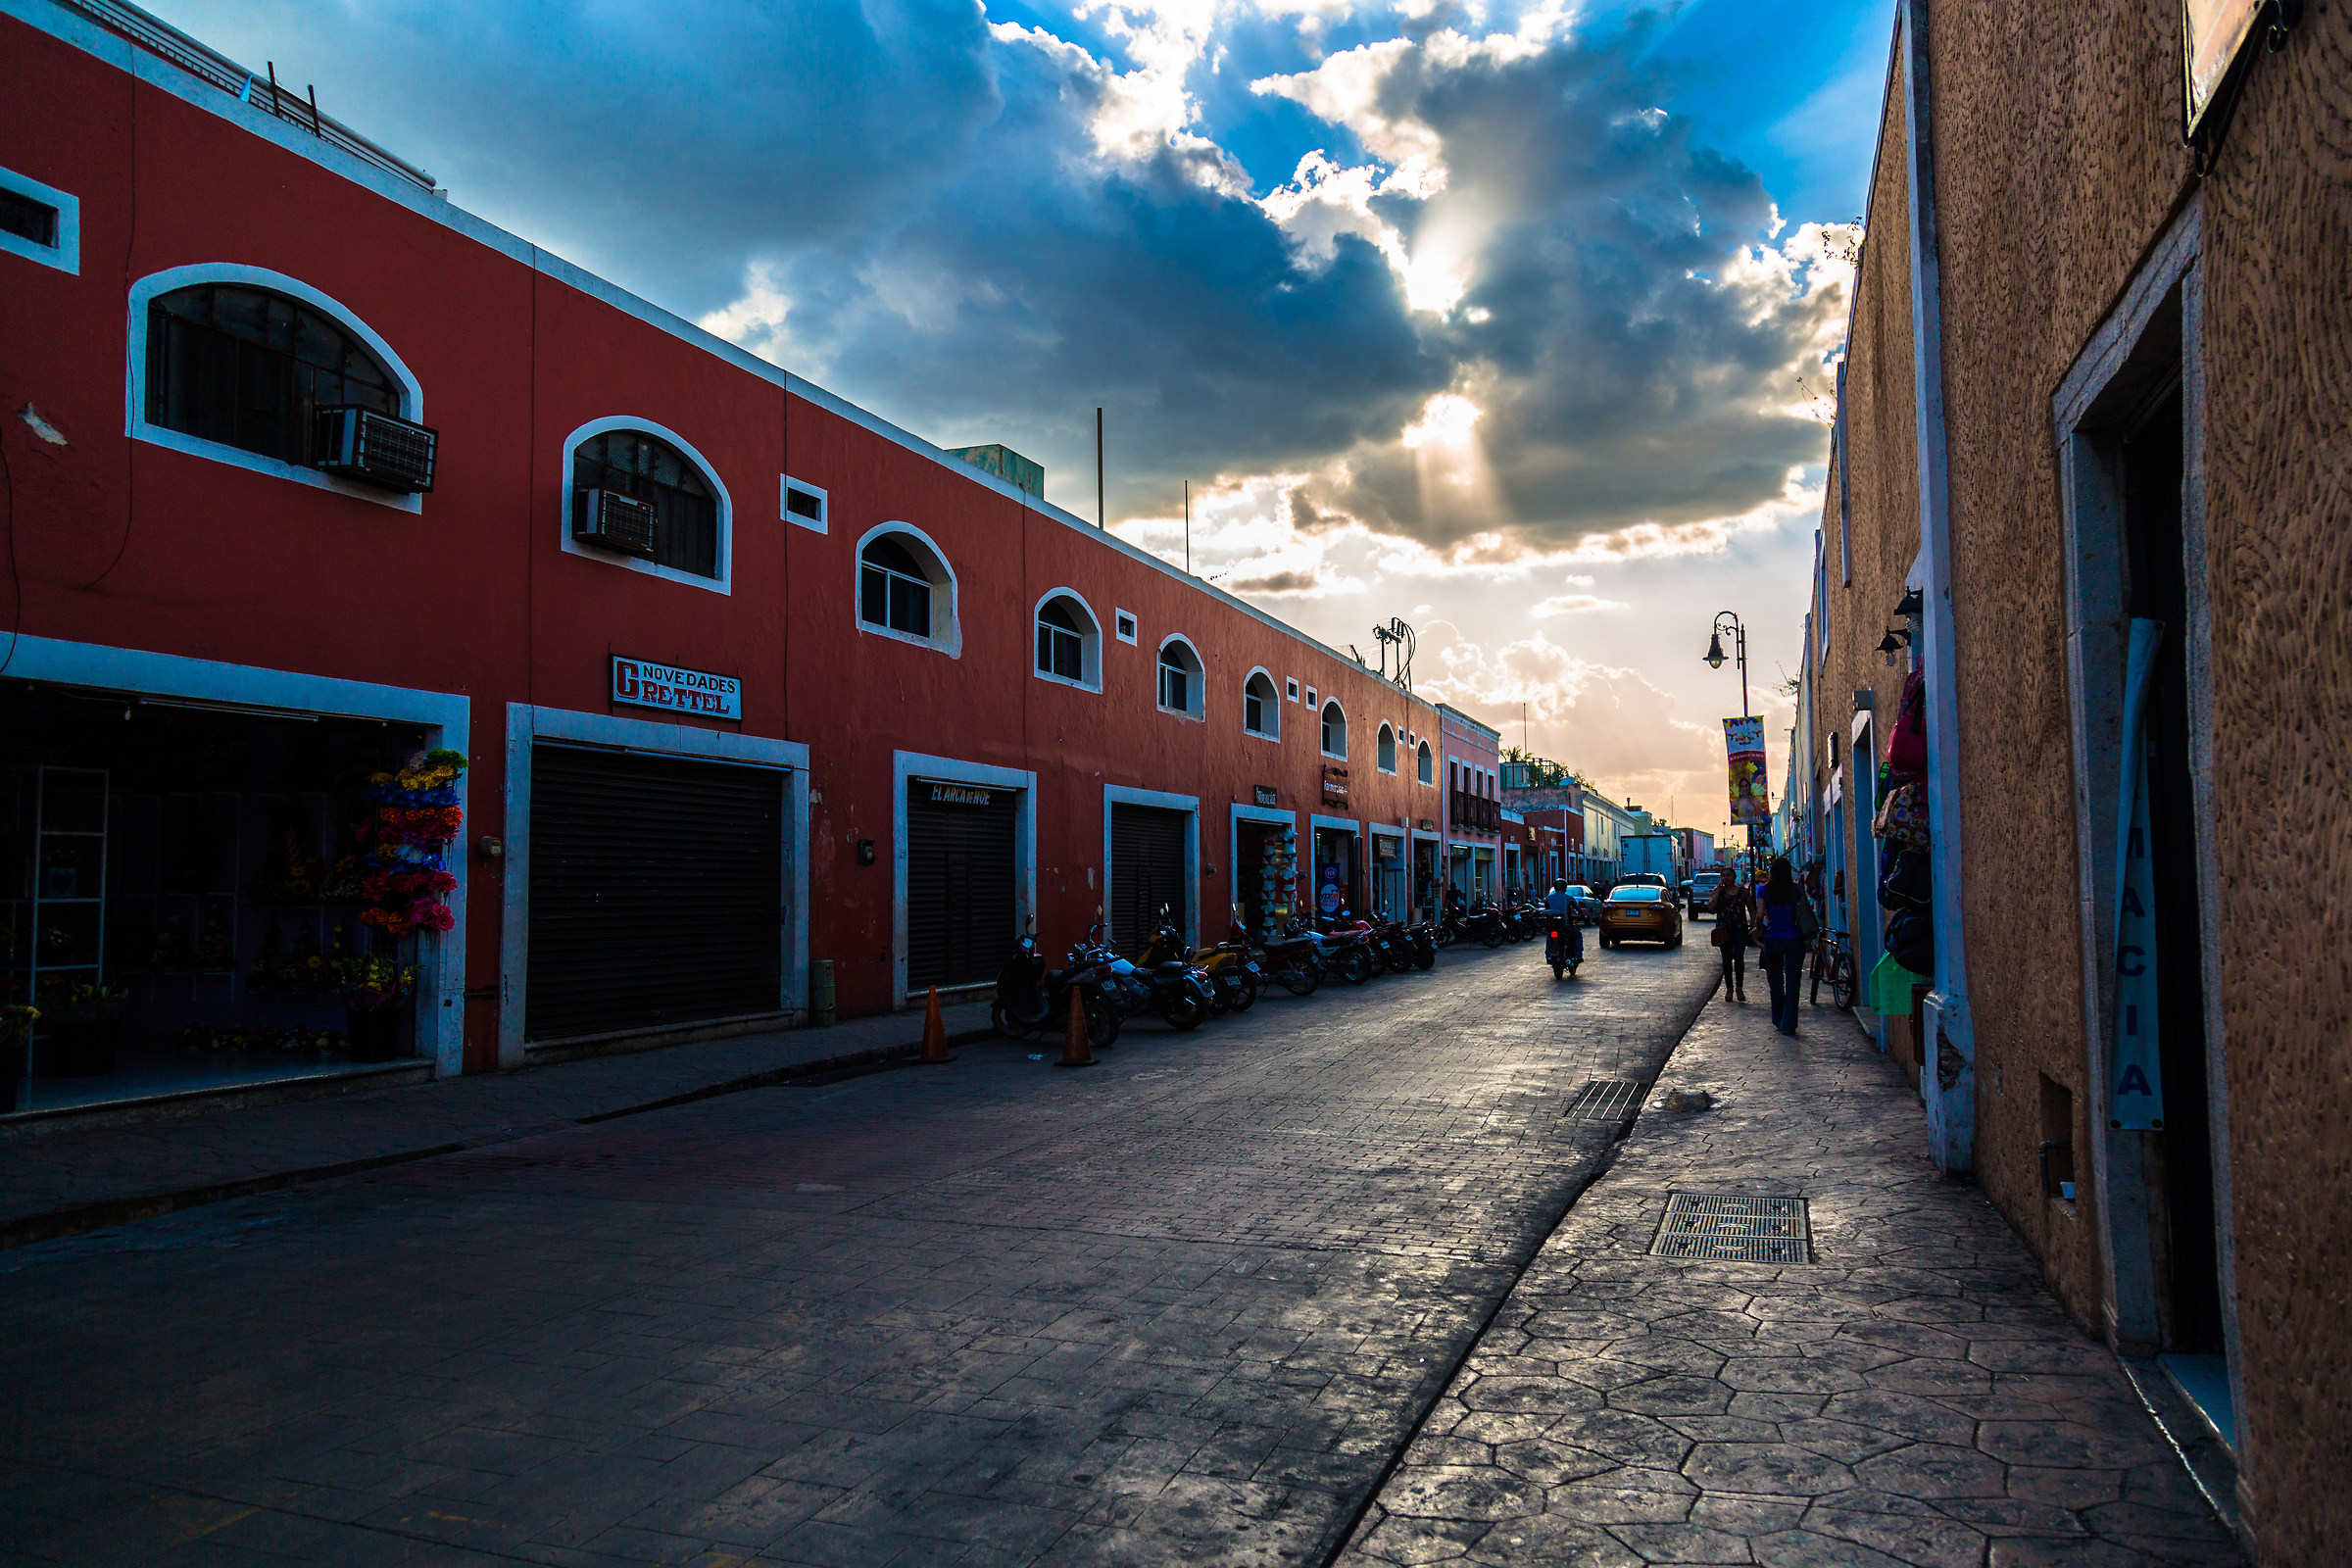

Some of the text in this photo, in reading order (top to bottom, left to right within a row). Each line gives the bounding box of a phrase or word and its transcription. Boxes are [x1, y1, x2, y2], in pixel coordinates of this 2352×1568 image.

[615, 660, 730, 714] GRETTEL
[643, 664, 736, 694] NOVEDADES
[931, 785, 942, 801] EL
[943, 786, 966, 804] ARCA
[2116, 790, 2153, 1096] MACIA
